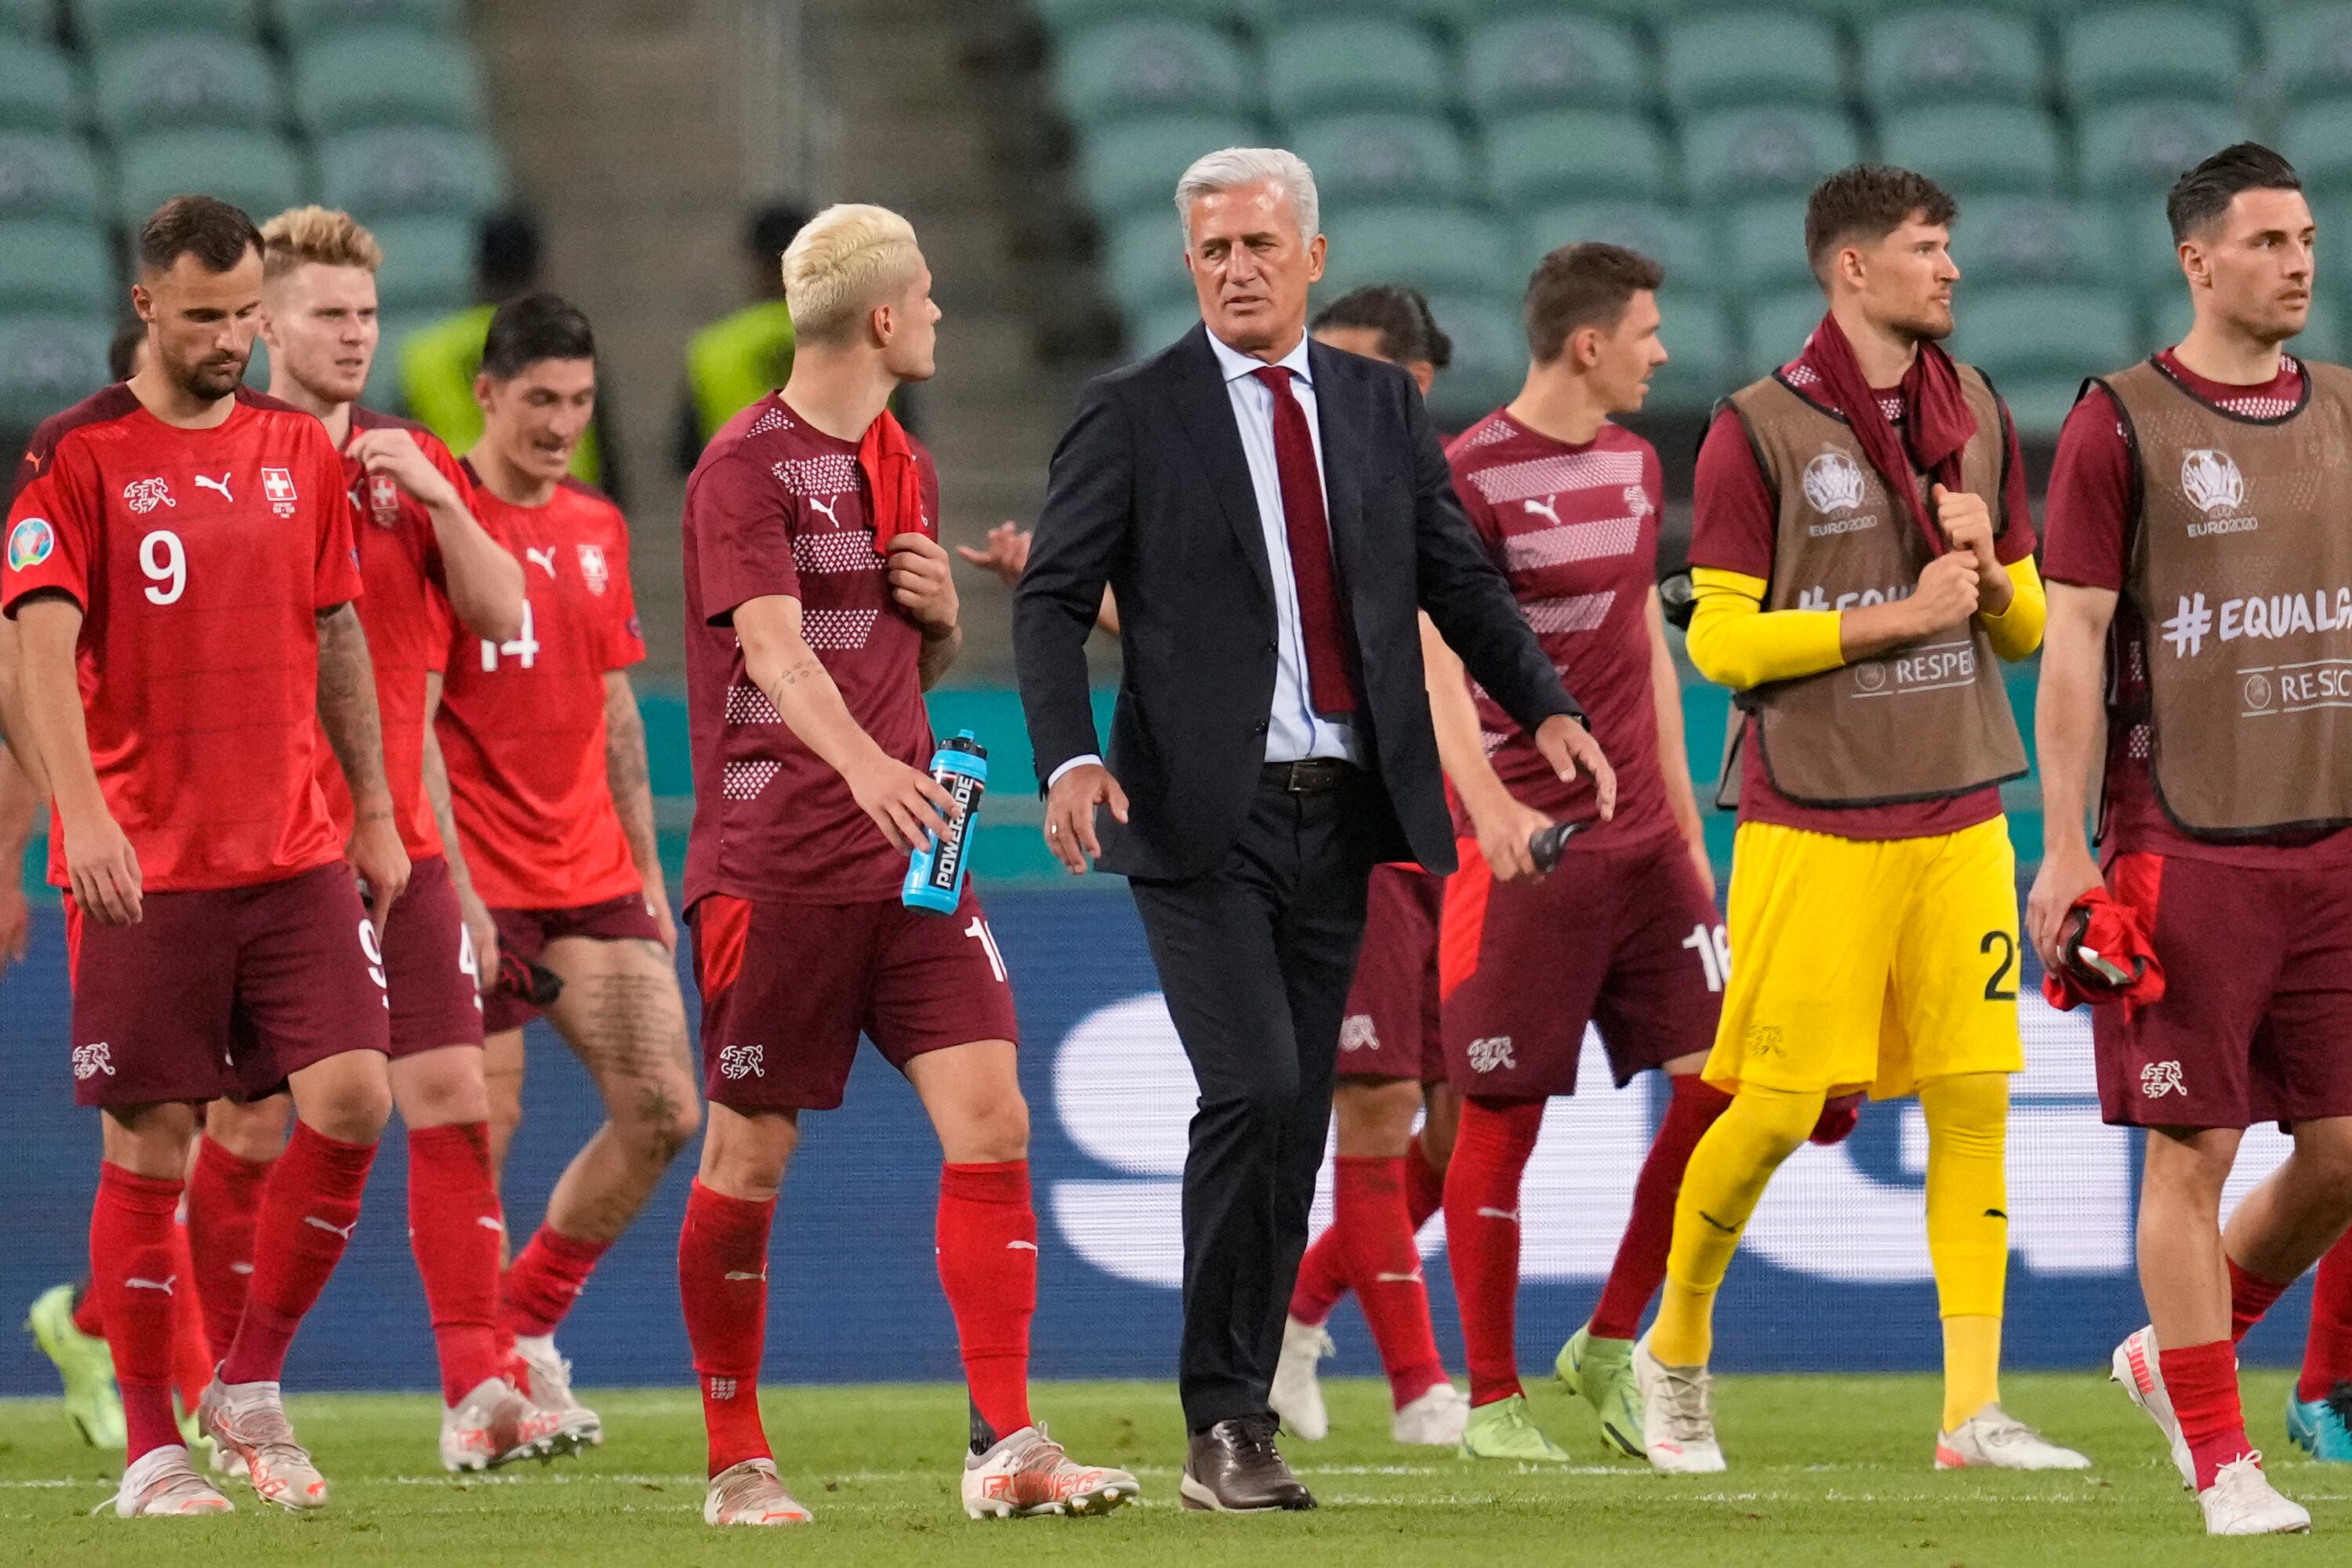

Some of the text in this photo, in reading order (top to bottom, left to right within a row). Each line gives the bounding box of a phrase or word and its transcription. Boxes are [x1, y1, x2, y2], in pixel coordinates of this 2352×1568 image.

[139, 530, 187, 605] 9
[1896, 647, 1975, 684] RESPE
[964, 916, 1008, 982] 1
